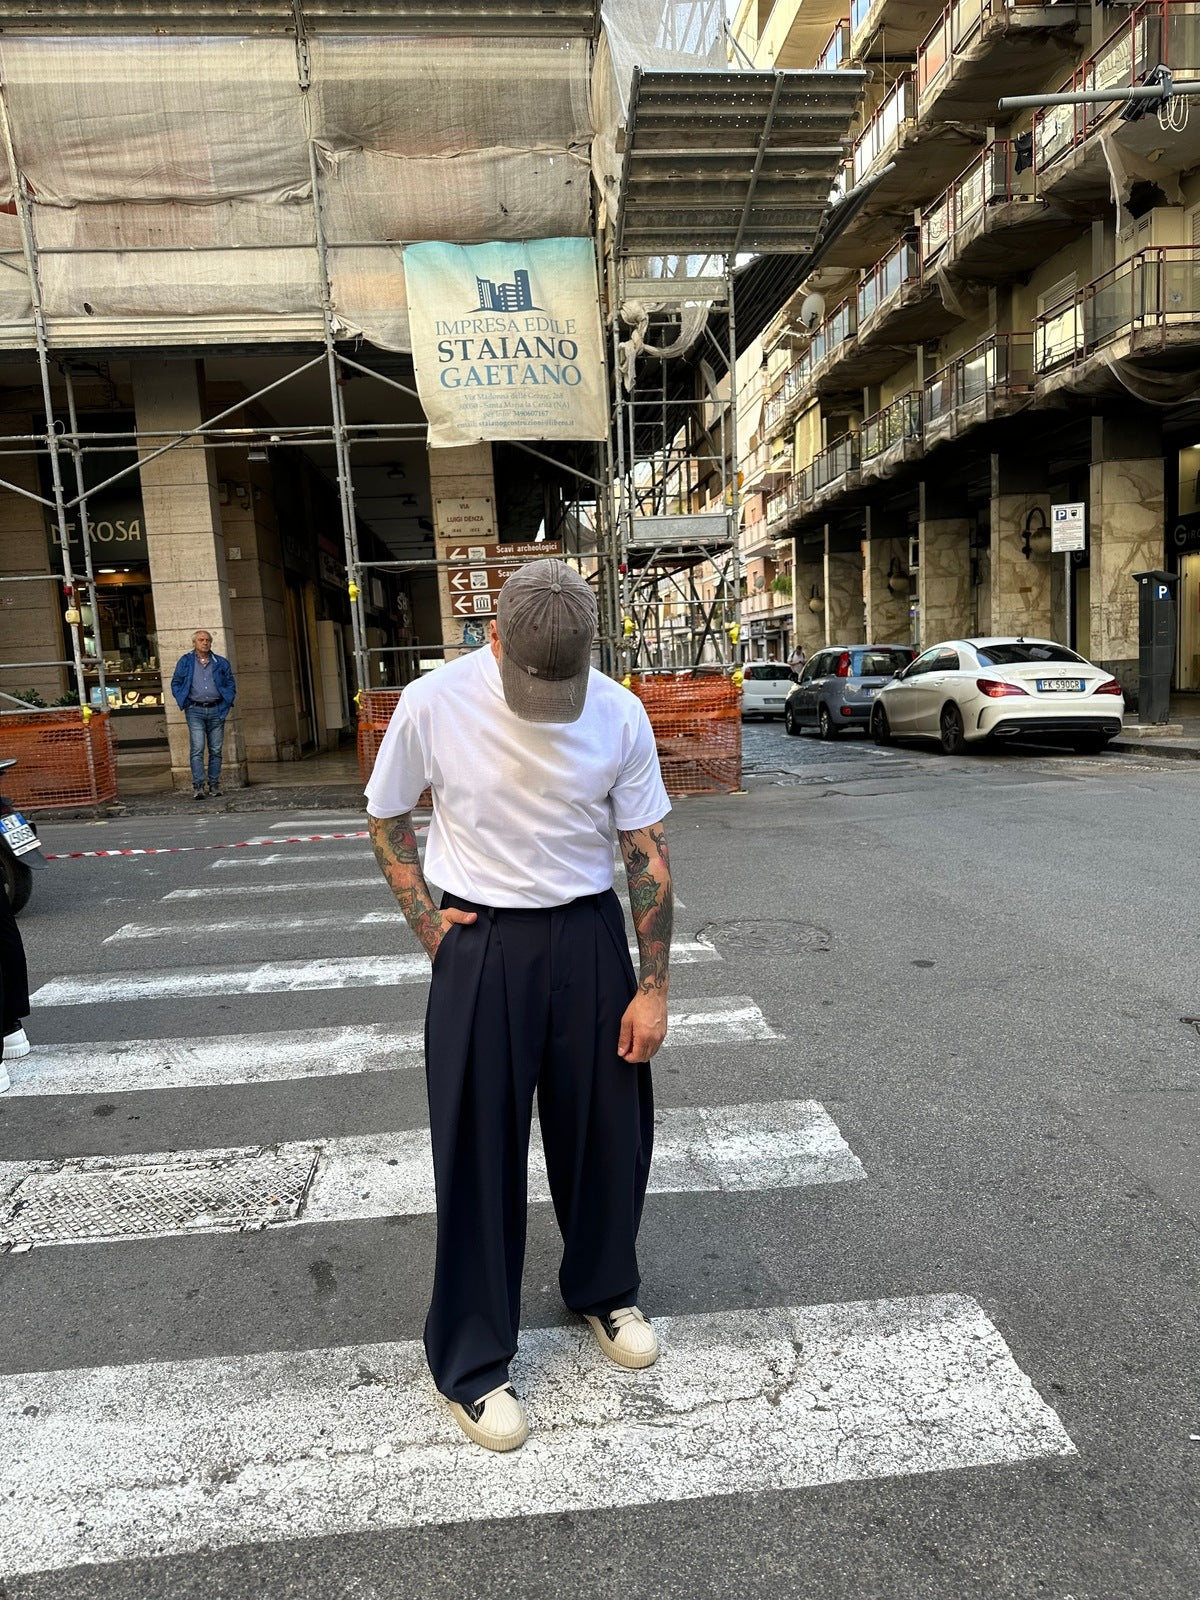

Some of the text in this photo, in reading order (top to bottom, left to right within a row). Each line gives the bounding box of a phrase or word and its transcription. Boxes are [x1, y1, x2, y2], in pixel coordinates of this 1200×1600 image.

[435, 317, 577, 336] IMPRESA EDILE
[437, 336, 579, 363] STAIANO
[440, 364, 582, 389] GAETANO
[1058, 510, 1066, 520] P
[87, 519, 141, 543] ROSA
[496, 542, 558, 554] Scavi archeologici
[1158, 585, 1168, 599] P
